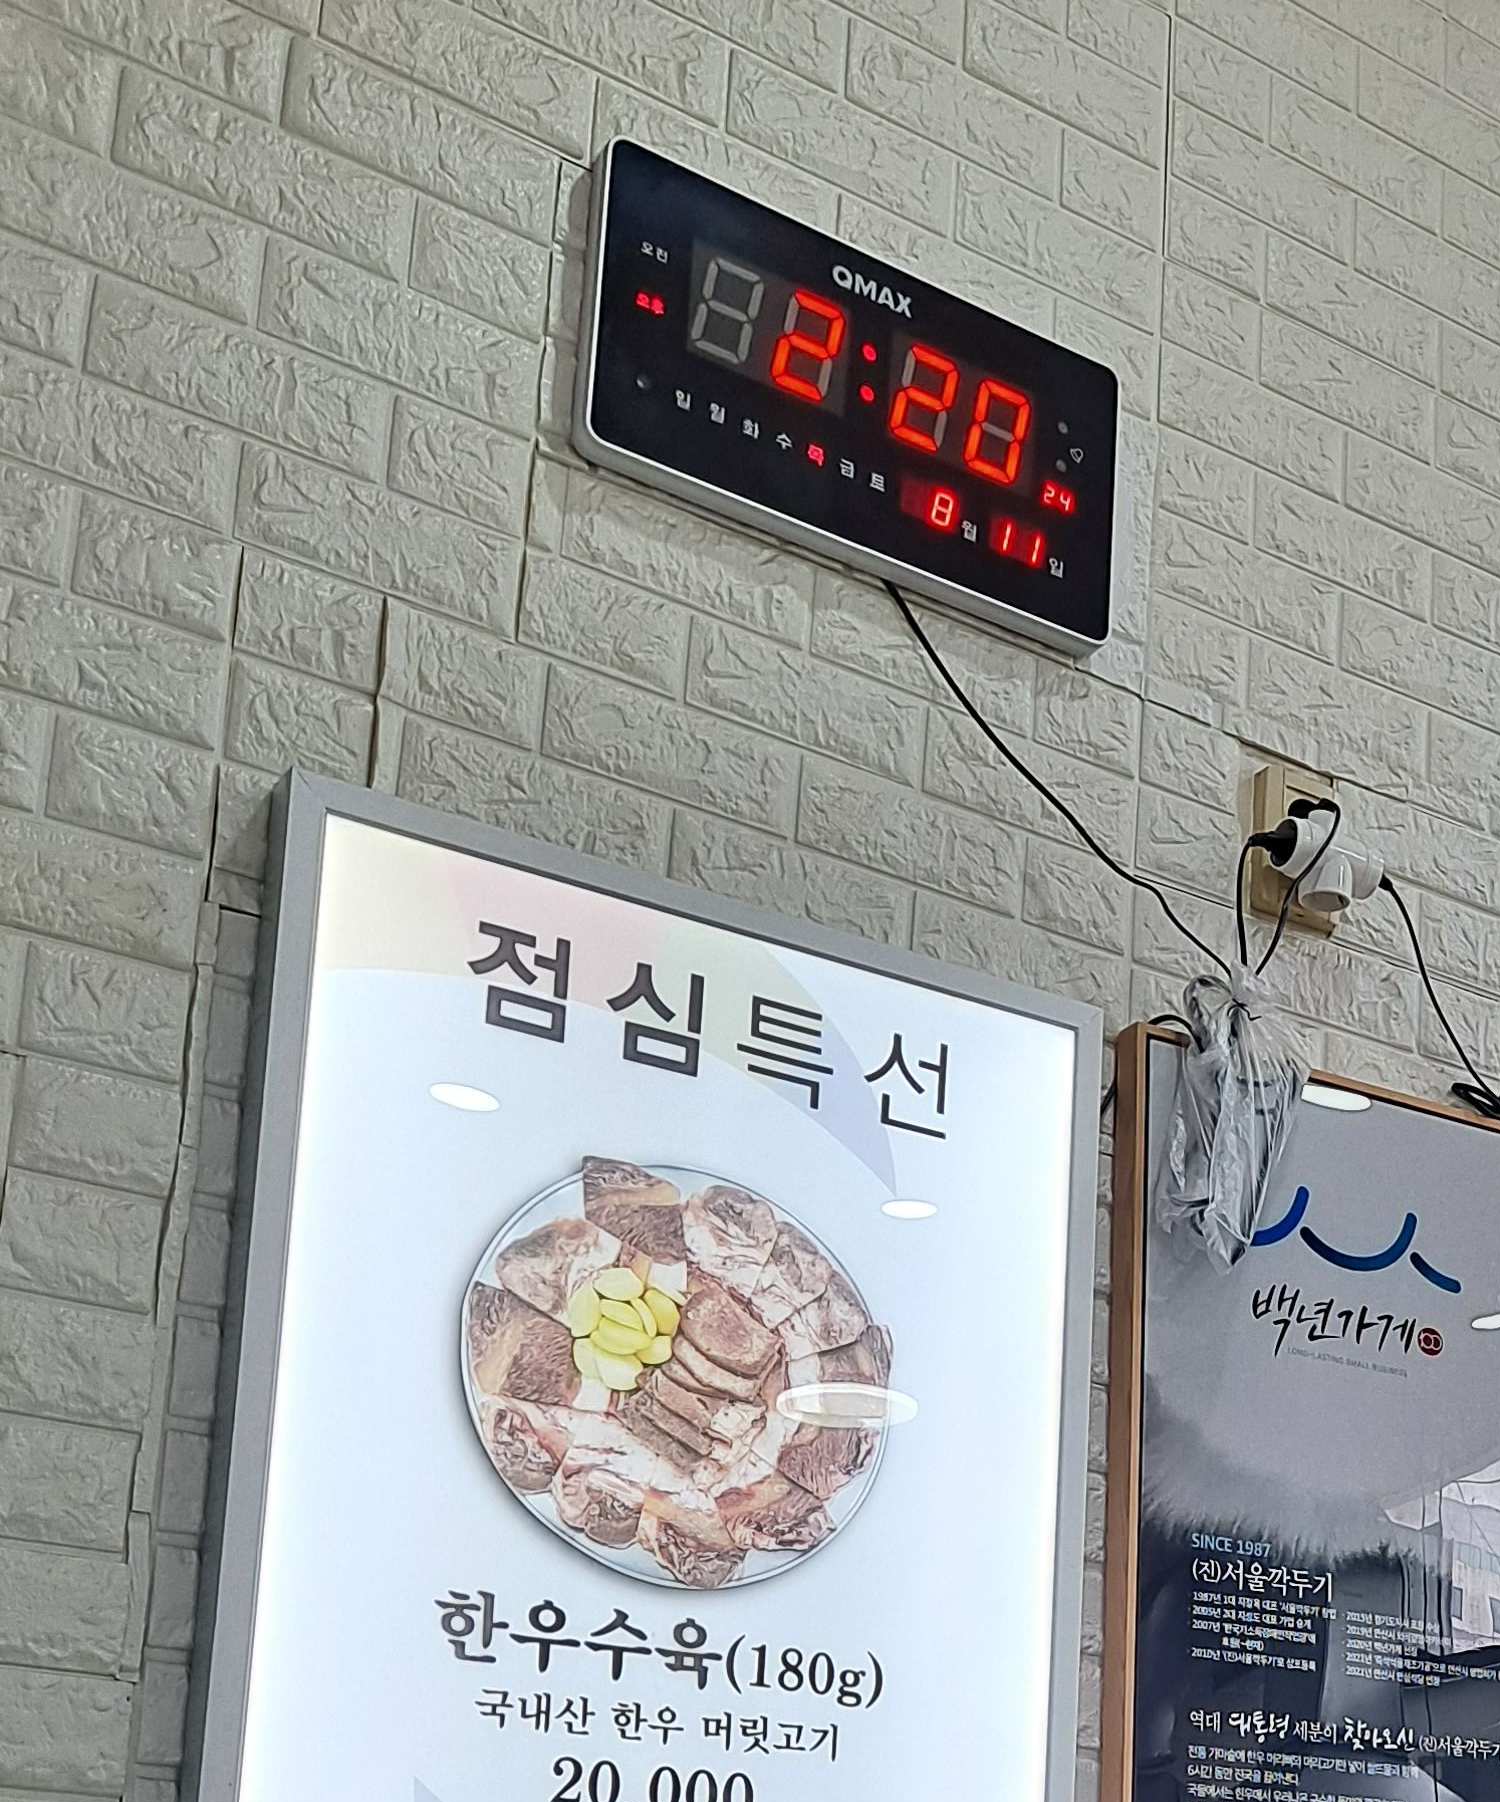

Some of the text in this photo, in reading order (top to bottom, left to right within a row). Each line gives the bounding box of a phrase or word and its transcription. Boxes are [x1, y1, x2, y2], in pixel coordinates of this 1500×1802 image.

[832, 265, 912, 318] QMAX
[770, 288, 1032, 486] 2:20
[775, 432, 793, 451] 수
[839, 458, 855, 479] 금
[869, 472, 886, 493] 토
[1042, 482, 1073, 513] 24
[1252, 1283, 1417, 1358] 백년가게
[1192, 1533, 1271, 1558] SINCE 1987
[1192, 1559, 1332, 1602] (진)서울깍두기
[434, 1590, 884, 1709] 한우수육(180g)
[475, 1688, 839, 1761] 국내산 한우 머릿고기
[1190, 1710, 1220, 1734] 역대
[1229, 1711, 1290, 1743] 대통령
[1293, 1721, 1337, 1745] 세분이
[1343, 1716, 1415, 1751] 찾아오신
